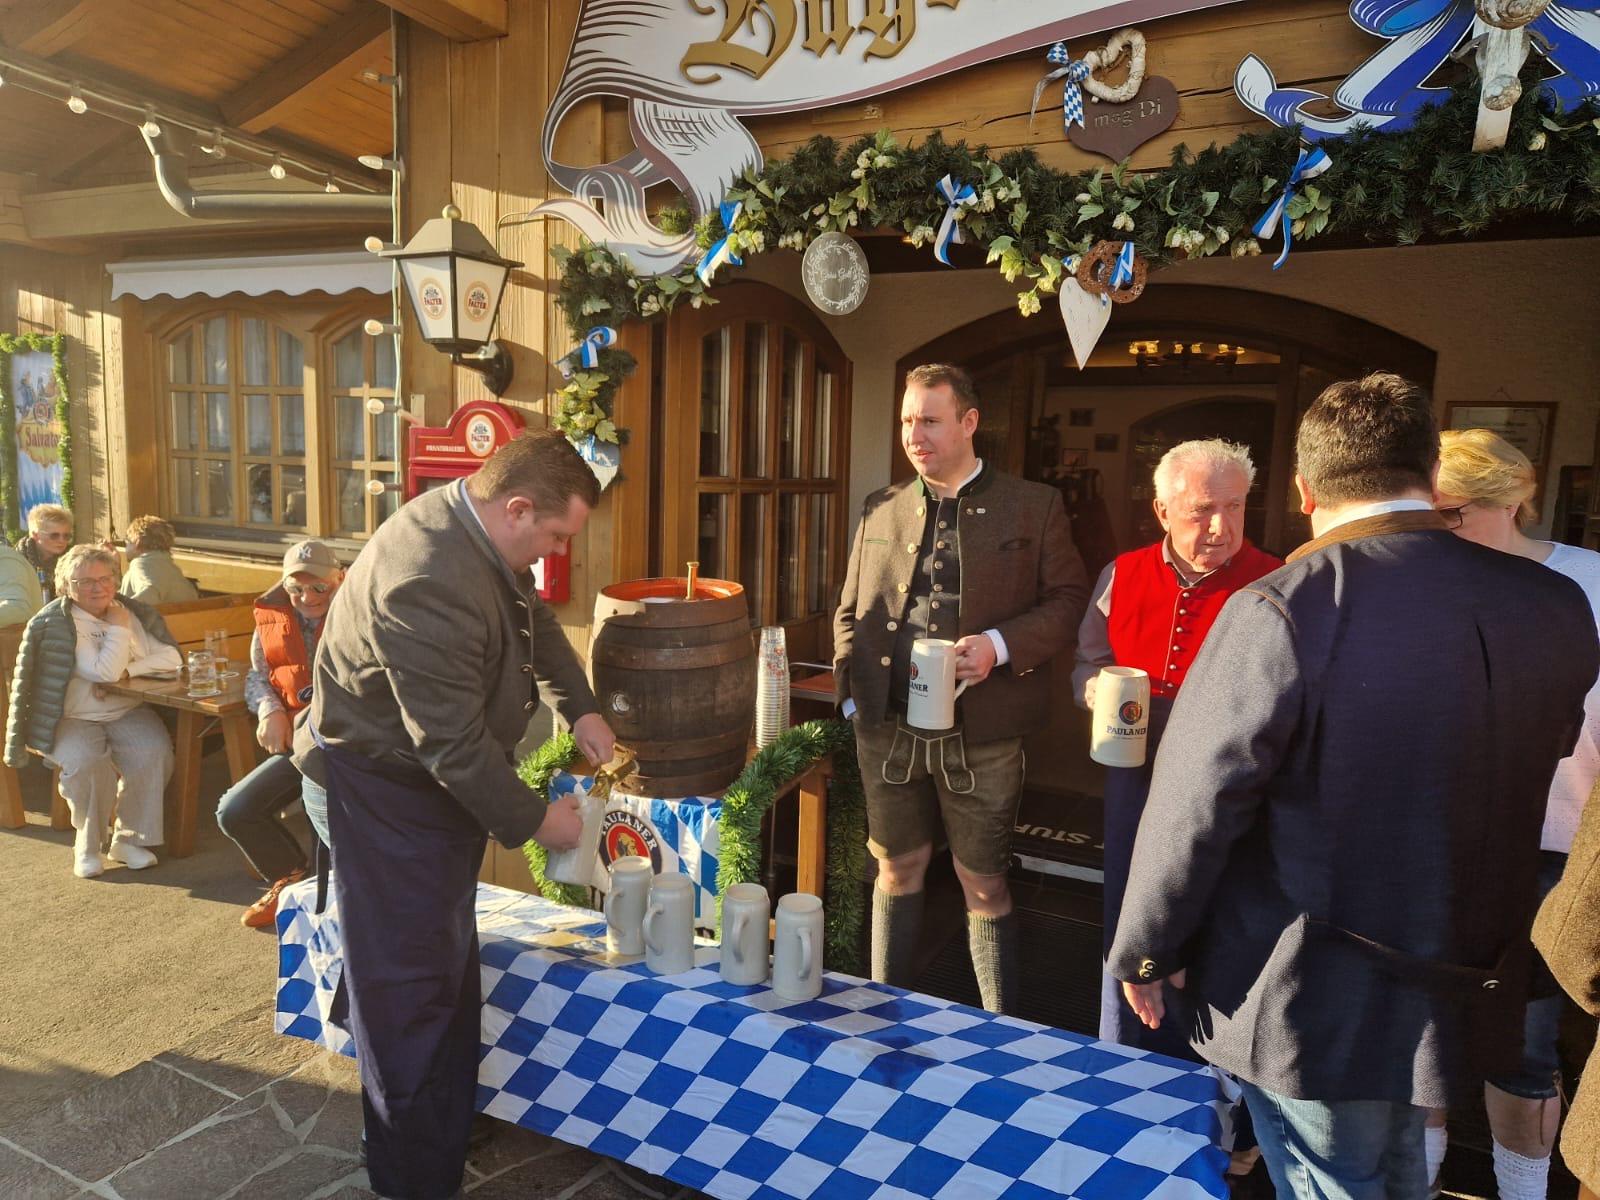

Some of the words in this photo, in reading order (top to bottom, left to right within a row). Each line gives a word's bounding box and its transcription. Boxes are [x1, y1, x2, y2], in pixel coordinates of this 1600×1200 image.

[680, 0, 958, 81] Bay
[1139, 98, 1161, 118] Di
[25, 426, 58, 448] Salvato
[910, 681, 928, 692] ANER
[602, 811, 658, 850] AULANER
[1014, 824, 1092, 844] STUF
